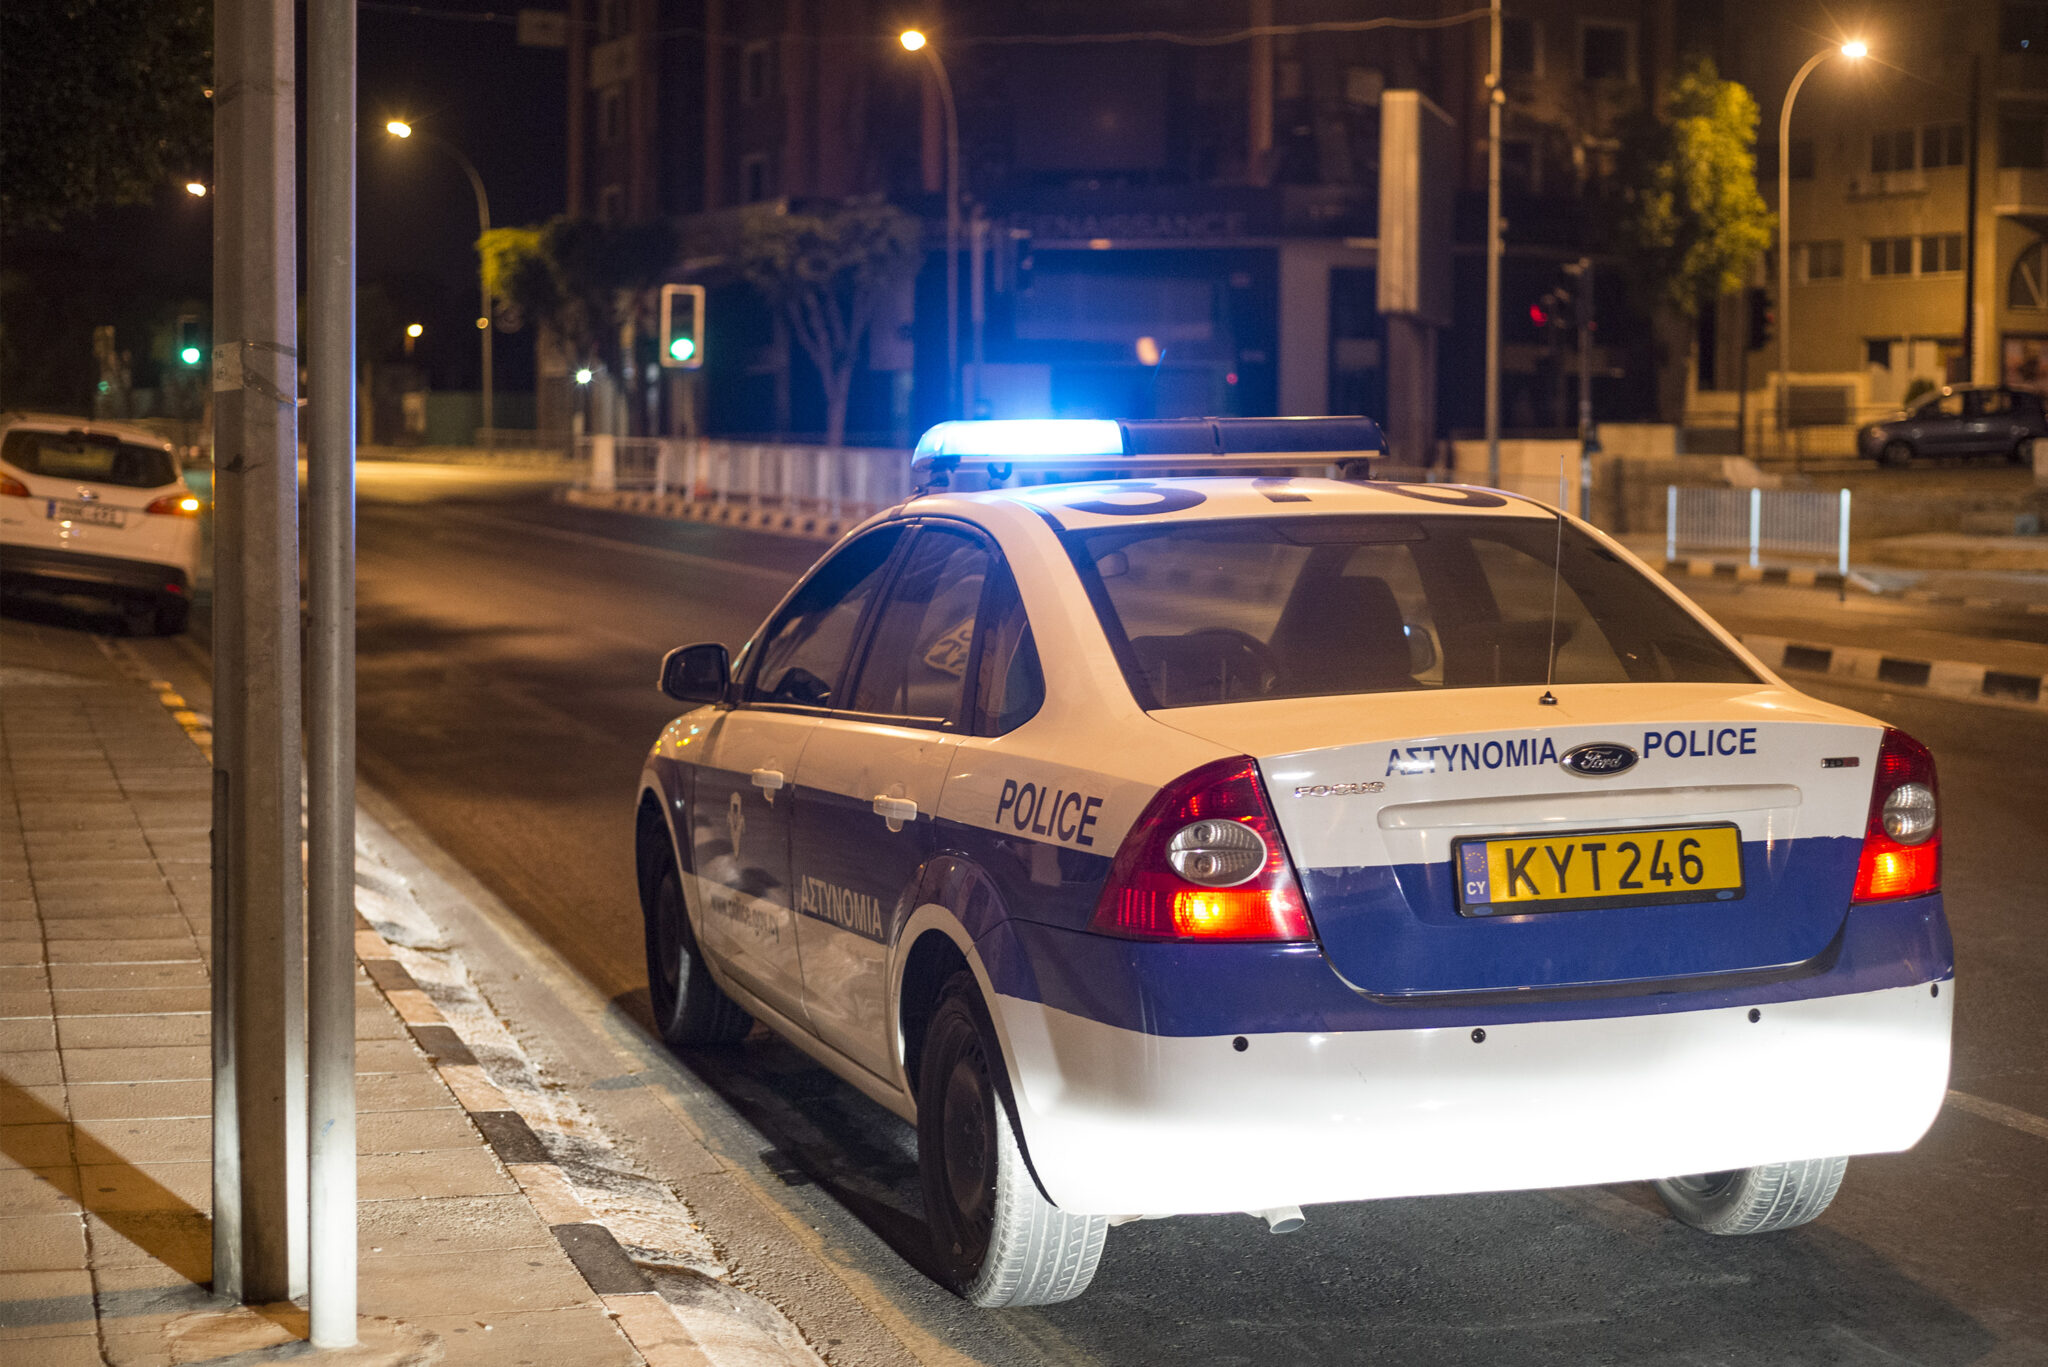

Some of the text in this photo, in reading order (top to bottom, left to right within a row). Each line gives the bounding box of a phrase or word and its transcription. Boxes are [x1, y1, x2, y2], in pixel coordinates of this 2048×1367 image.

[1385, 737, 1559, 777] ΑΣΤΥΝΟΜΙΑ
[1580, 750, 1623, 770] Ford
[1643, 728, 1758, 759] POLICE
[1294, 781, 1385, 798] FOCUS
[995, 778, 1104, 848] POLICE
[1504, 838, 1705, 897] KYT246
[1465, 880, 1487, 896] CY
[800, 874, 884, 939] ΑΣΤΥΝΟΜΙΑ
